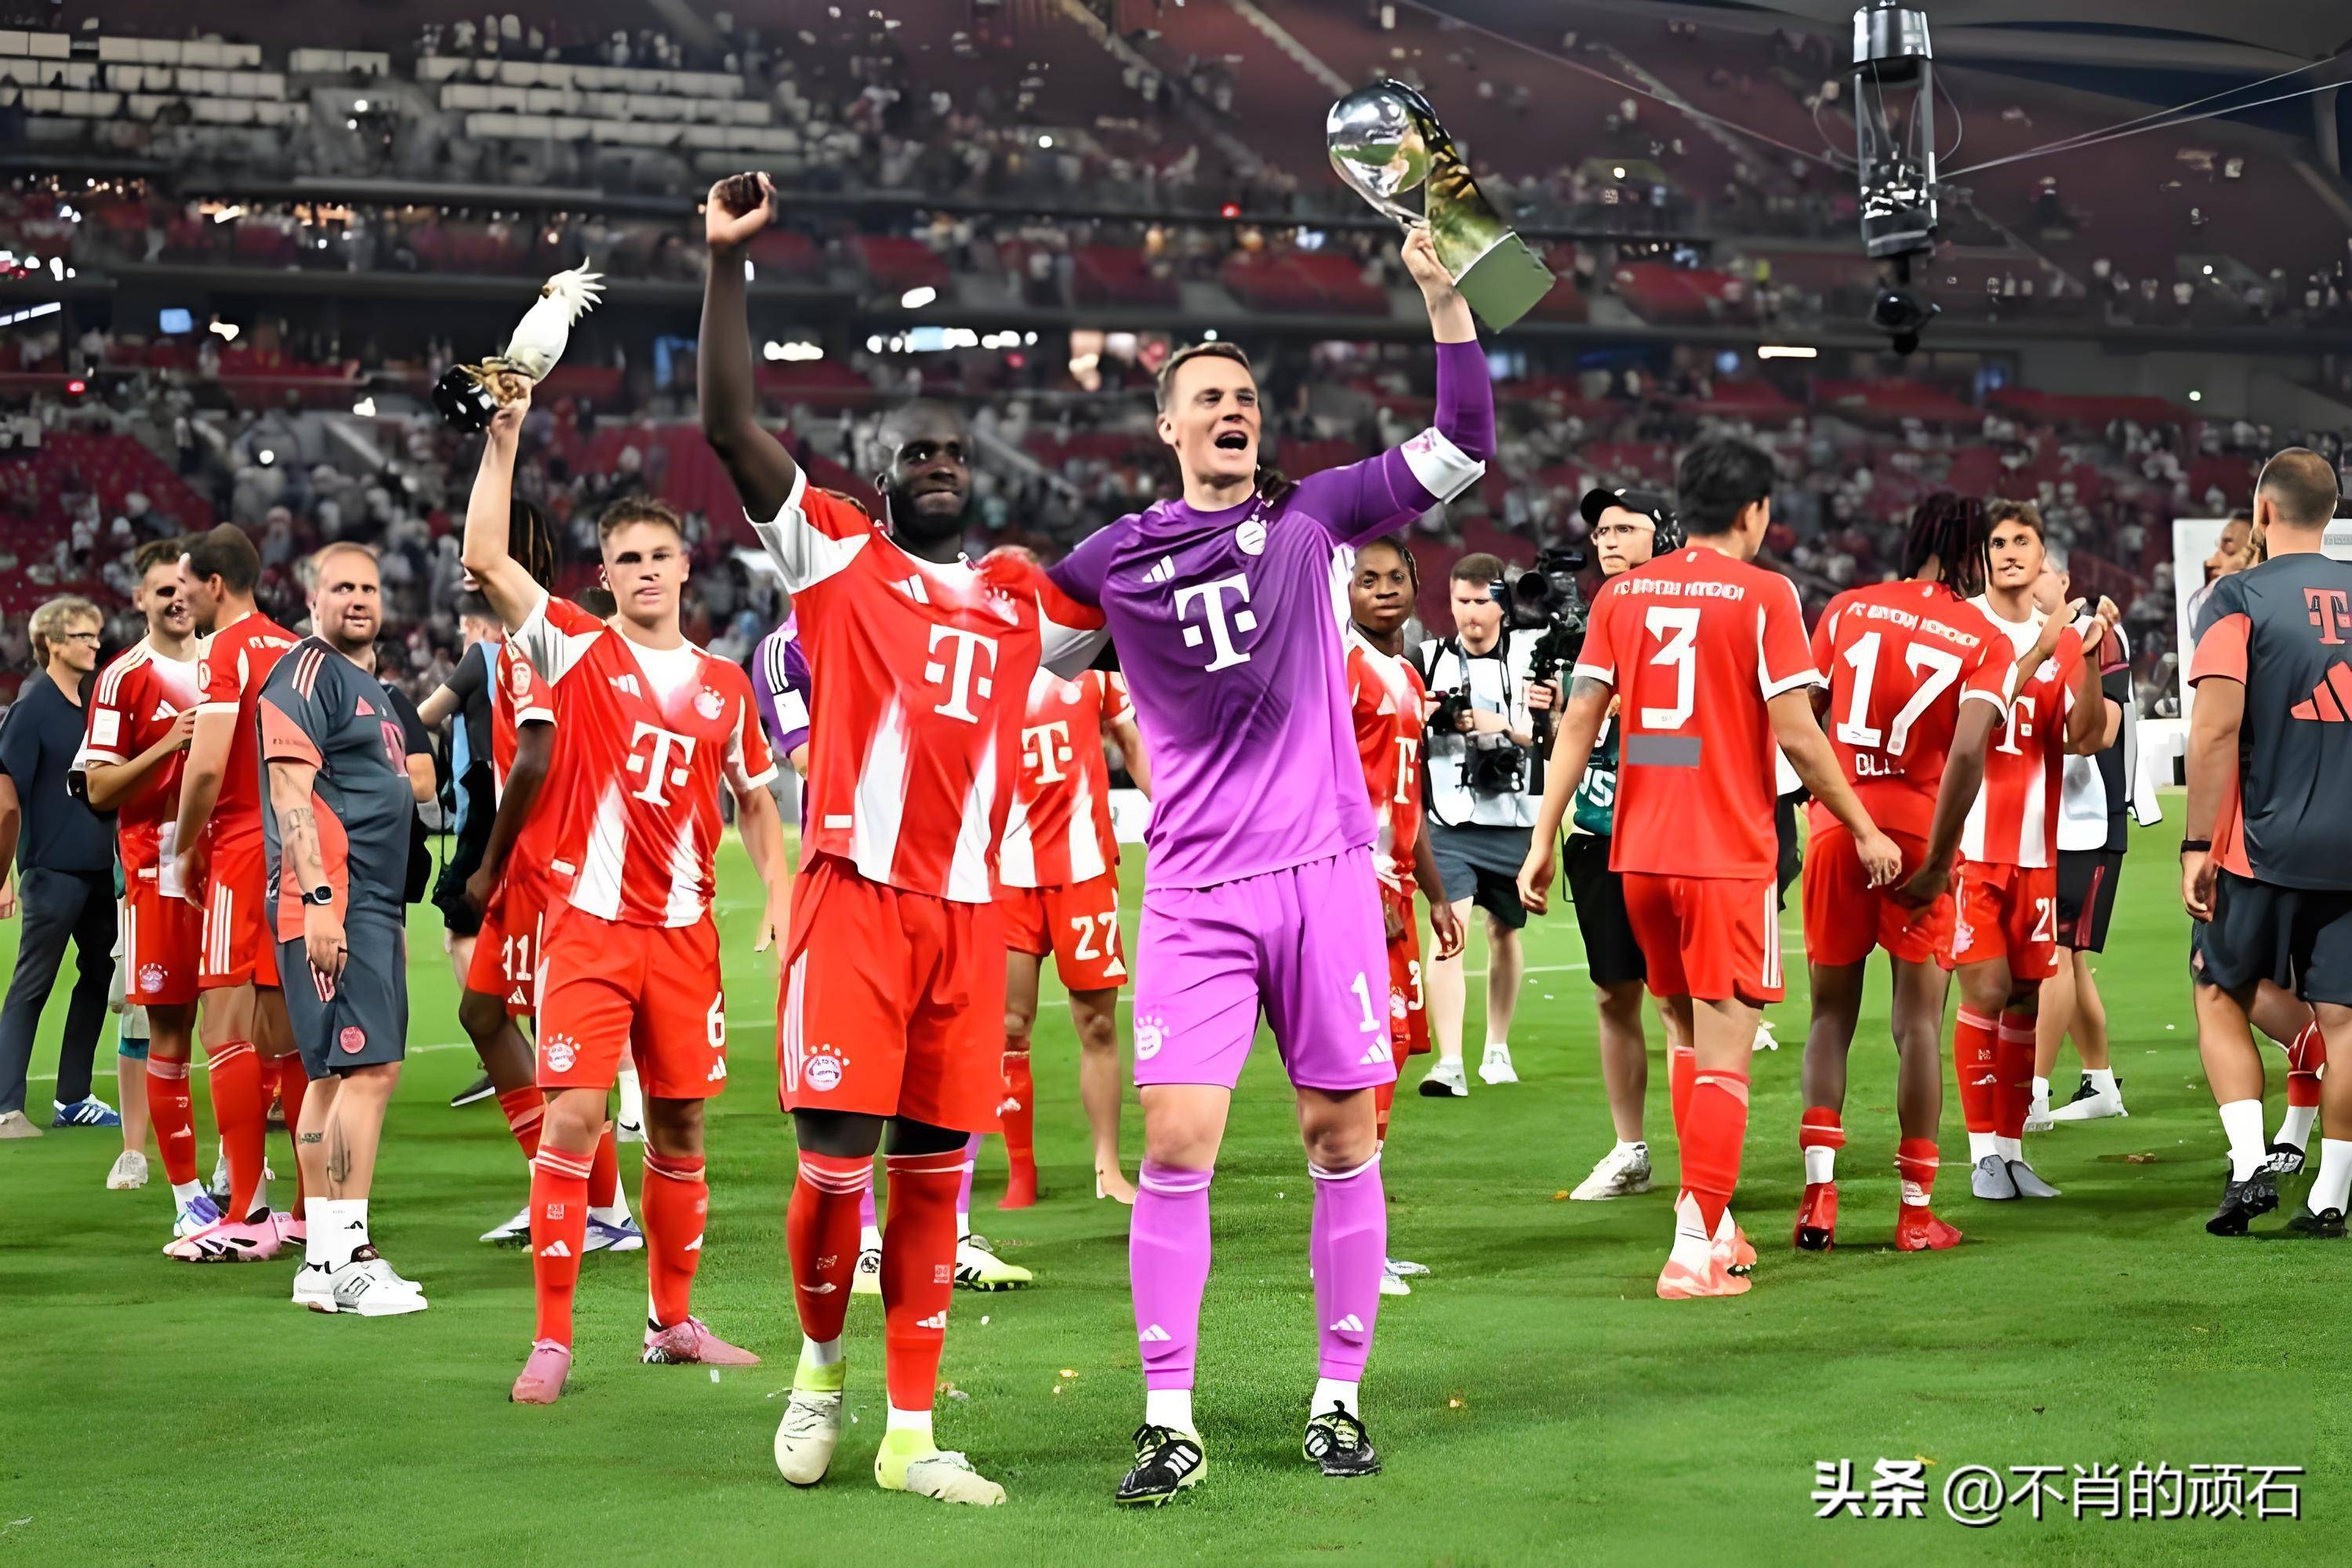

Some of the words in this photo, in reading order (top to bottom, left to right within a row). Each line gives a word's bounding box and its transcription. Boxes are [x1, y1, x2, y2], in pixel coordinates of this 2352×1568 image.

[1176, 573, 1258, 673] T
[925, 624, 998, 724] T
[1641, 606, 1701, 730] 3
[1837, 631, 1963, 756] 17
[626, 720, 696, 807] T
[1022, 720, 1073, 784] T
[502, 934, 532, 981] 11
[1071, 911, 1117, 960] 27
[707, 991, 725, 1048] 6
[1350, 971, 1381, 1033] 1
